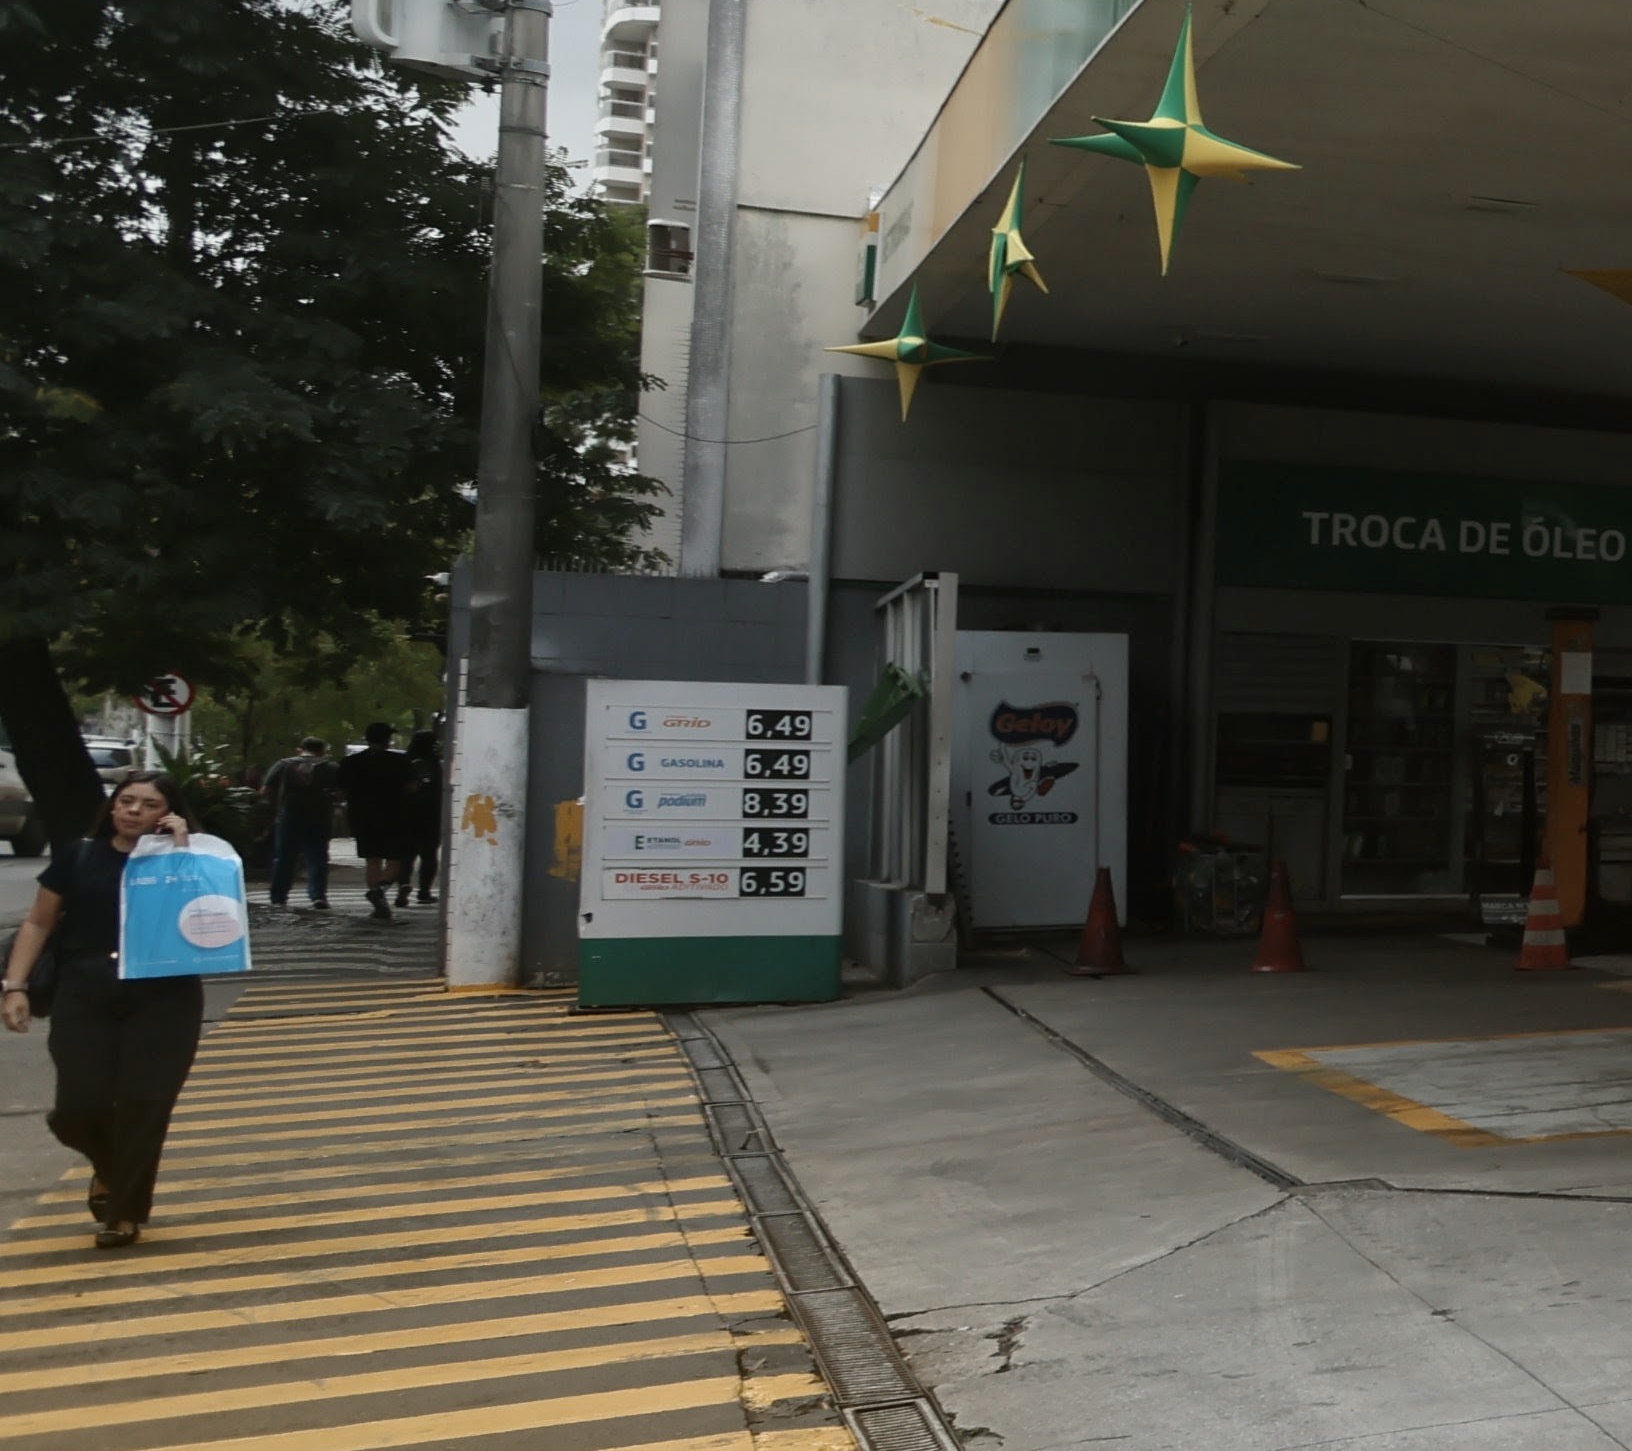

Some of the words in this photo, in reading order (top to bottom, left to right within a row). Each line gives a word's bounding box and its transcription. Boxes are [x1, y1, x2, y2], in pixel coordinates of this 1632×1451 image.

[1302, 511, 1446, 551] TROCA
[1459, 520, 1511, 554] DE
[1521, 516, 1626, 561] ÓLEO
[629, 711, 647, 730] G
[747, 714, 811, 738] 6,49
[627, 753, 645, 772] G
[661, 759, 724, 769] GASOLINA
[746, 754, 808, 776] 6,49
[625, 791, 643, 809] G
[744, 793, 807, 817] 8,39
[995, 814, 1030, 823] GELO
[1035, 814, 1072, 823] PURO
[635, 835, 645, 850] E
[744, 833, 807, 856] 4,39
[614, 873, 681, 884] DIESEL
[688, 873, 728, 884] S-10
[741, 871, 804, 894] 6,59
